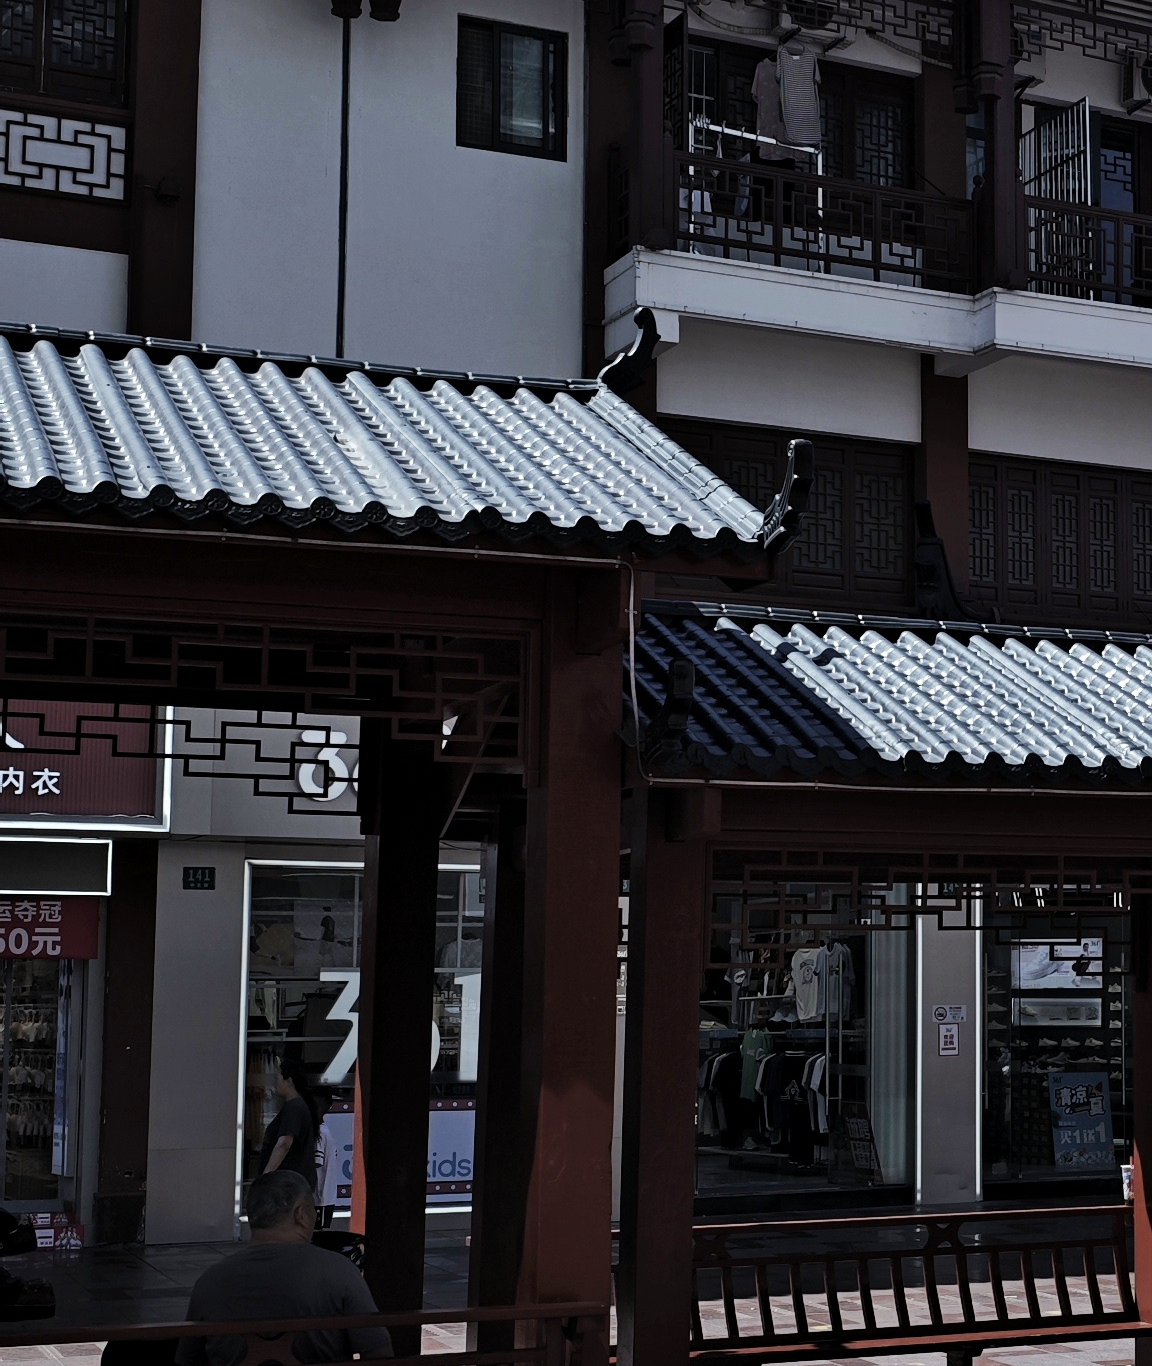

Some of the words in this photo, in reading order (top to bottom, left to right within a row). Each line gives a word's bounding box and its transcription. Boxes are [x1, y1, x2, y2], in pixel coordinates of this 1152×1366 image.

[188, 869, 210, 882] 141
[319, 968, 481, 1084] 31
[427, 1151, 472, 1178] ids
